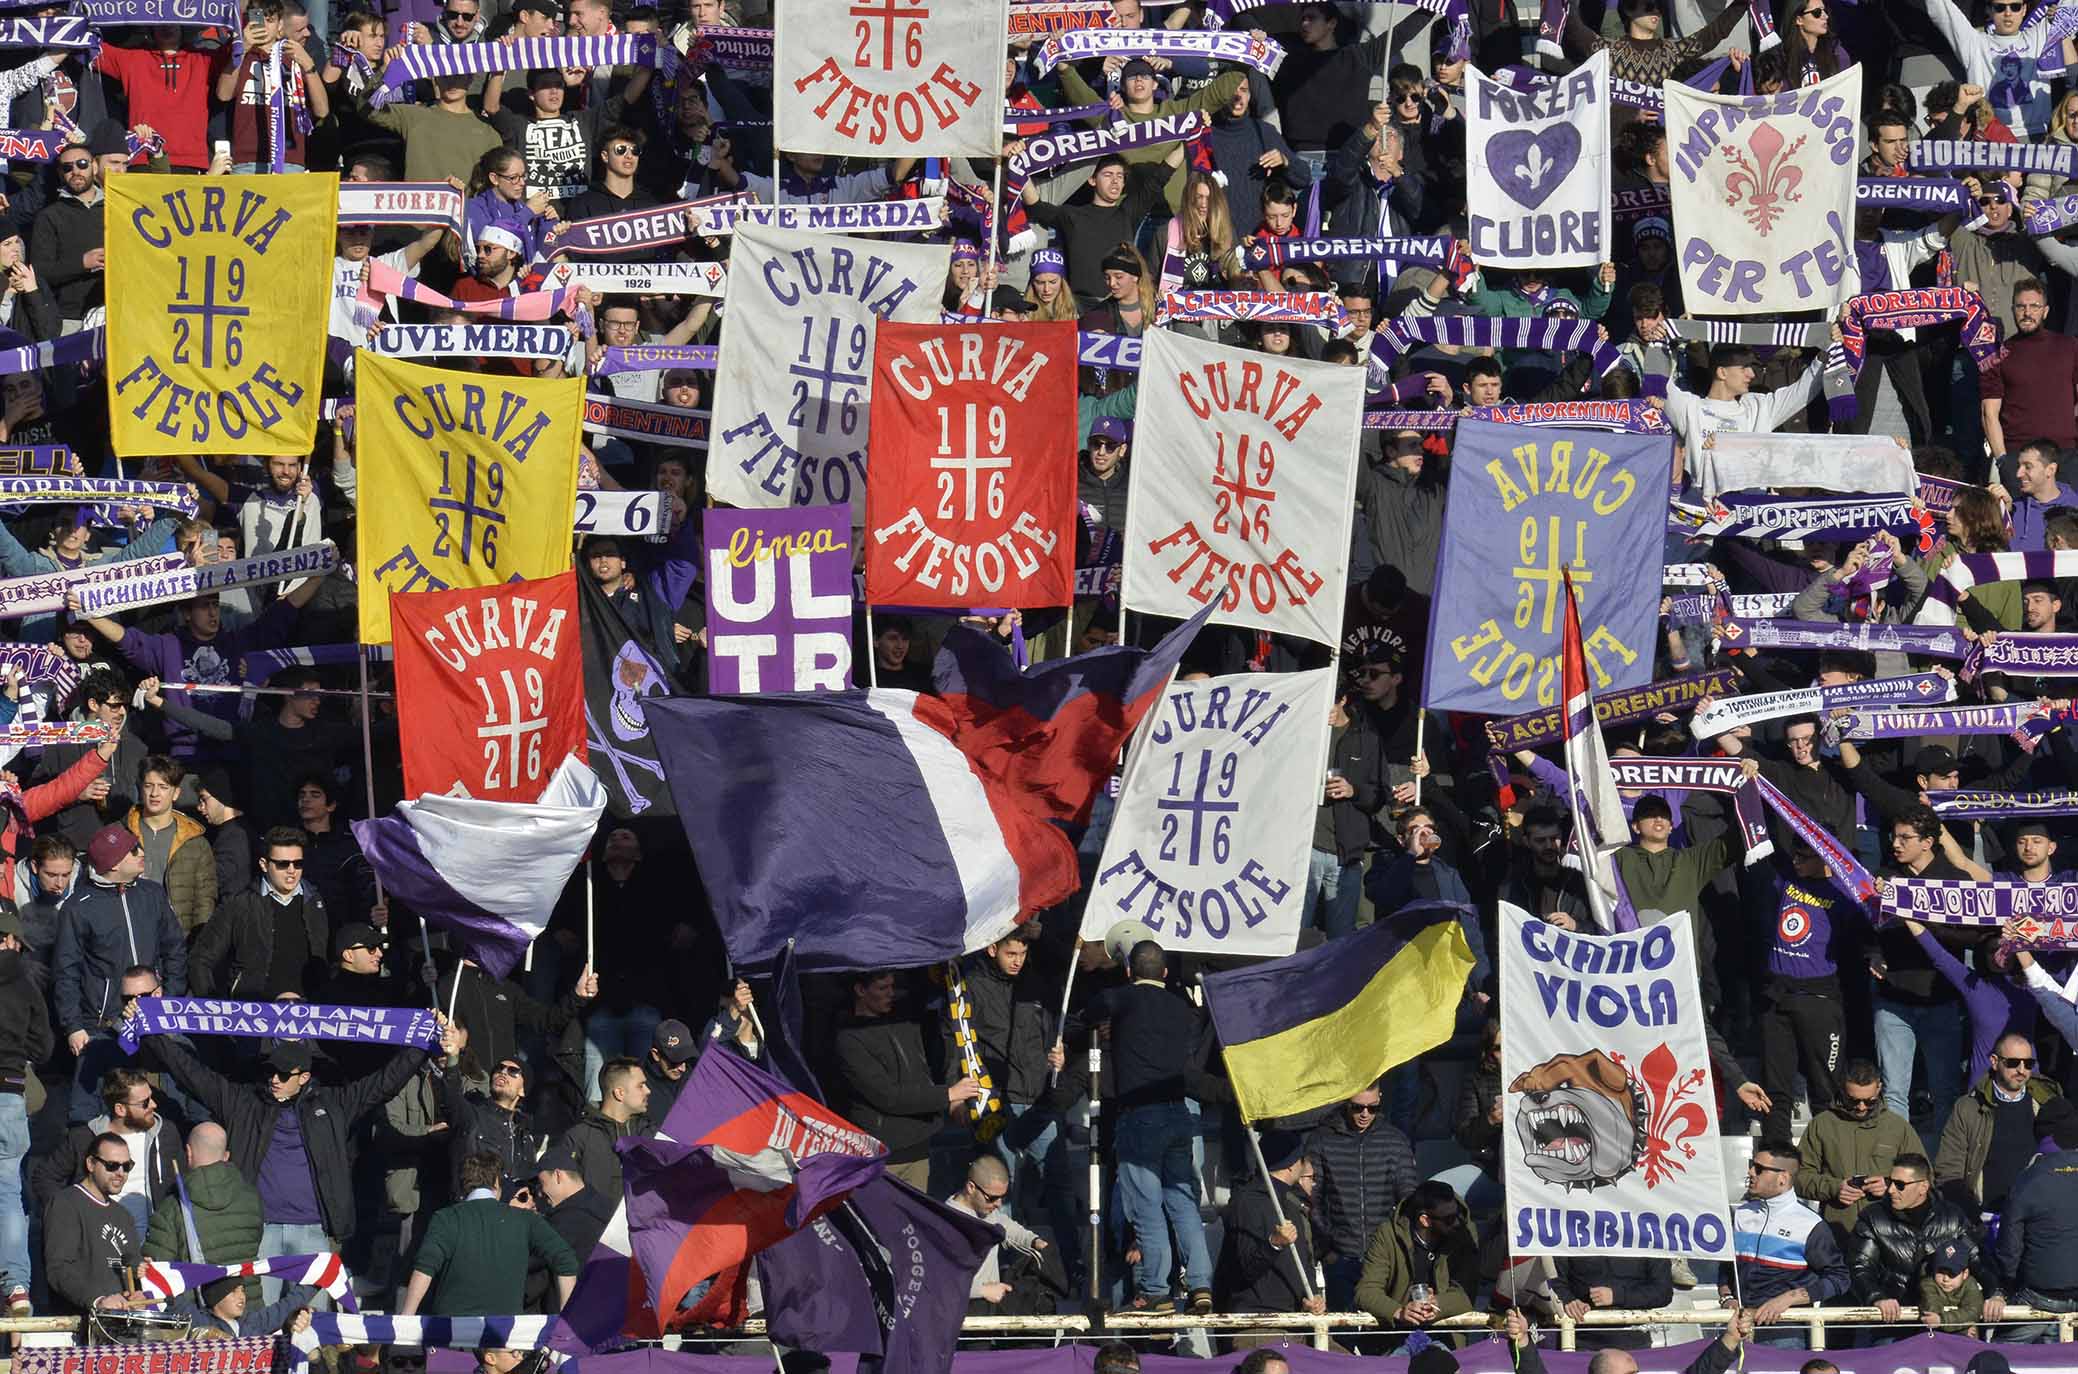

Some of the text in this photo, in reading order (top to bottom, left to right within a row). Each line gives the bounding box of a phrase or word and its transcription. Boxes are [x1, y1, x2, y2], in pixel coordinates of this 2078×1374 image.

[794, 57, 982, 145] FIESOLE
[1478, 71, 1597, 123] FORZA
[1008, 111, 1197, 177] FIORENTINA
[1911, 140, 2072, 174] FIORENTINA
[132, 186, 293, 255] CURVA
[808, 201, 932, 229] MERDA
[1471, 210, 1600, 258] CUORE
[577, 264, 702, 279] FIORENTINA
[1290, 238, 1444, 260] FIORENTINA
[1683, 237, 1766, 303] PER
[625, 279, 651, 289] 1926
[763, 247, 918, 320] CURVA
[369, 325, 455, 353] UVE
[891, 332, 1049, 402] CURVA
[116, 356, 304, 443] FIESOLE
[393, 383, 551, 463] CURVA
[1178, 361, 1323, 442] CURVA
[1734, 504, 1912, 530] FIORENTINA
[722, 527, 848, 568] linea
[874, 506, 1057, 597] FIESOLE
[1148, 520, 1324, 616] FIESOLE
[79, 546, 333, 613] INCHINATEVI A FIRENZE
[425, 597, 568, 673] CURVA
[1342, 626, 1369, 654] NEW
[1877, 706, 2014, 732] FORZA VIOLA
[1955, 793, 2020, 810] ONDA
[1099, 849, 1292, 940] FIESOLE
[161, 1000, 391, 1023] DASPO VOLANT
[1533, 970, 1678, 1028] VIOLA
[158, 1016, 269, 1034] ULTRAS
[273, 1019, 396, 1041] MANENT
[1515, 1207, 1727, 1253] SUBBIANO
[63, 1348, 275, 1374] FIORENTINA
